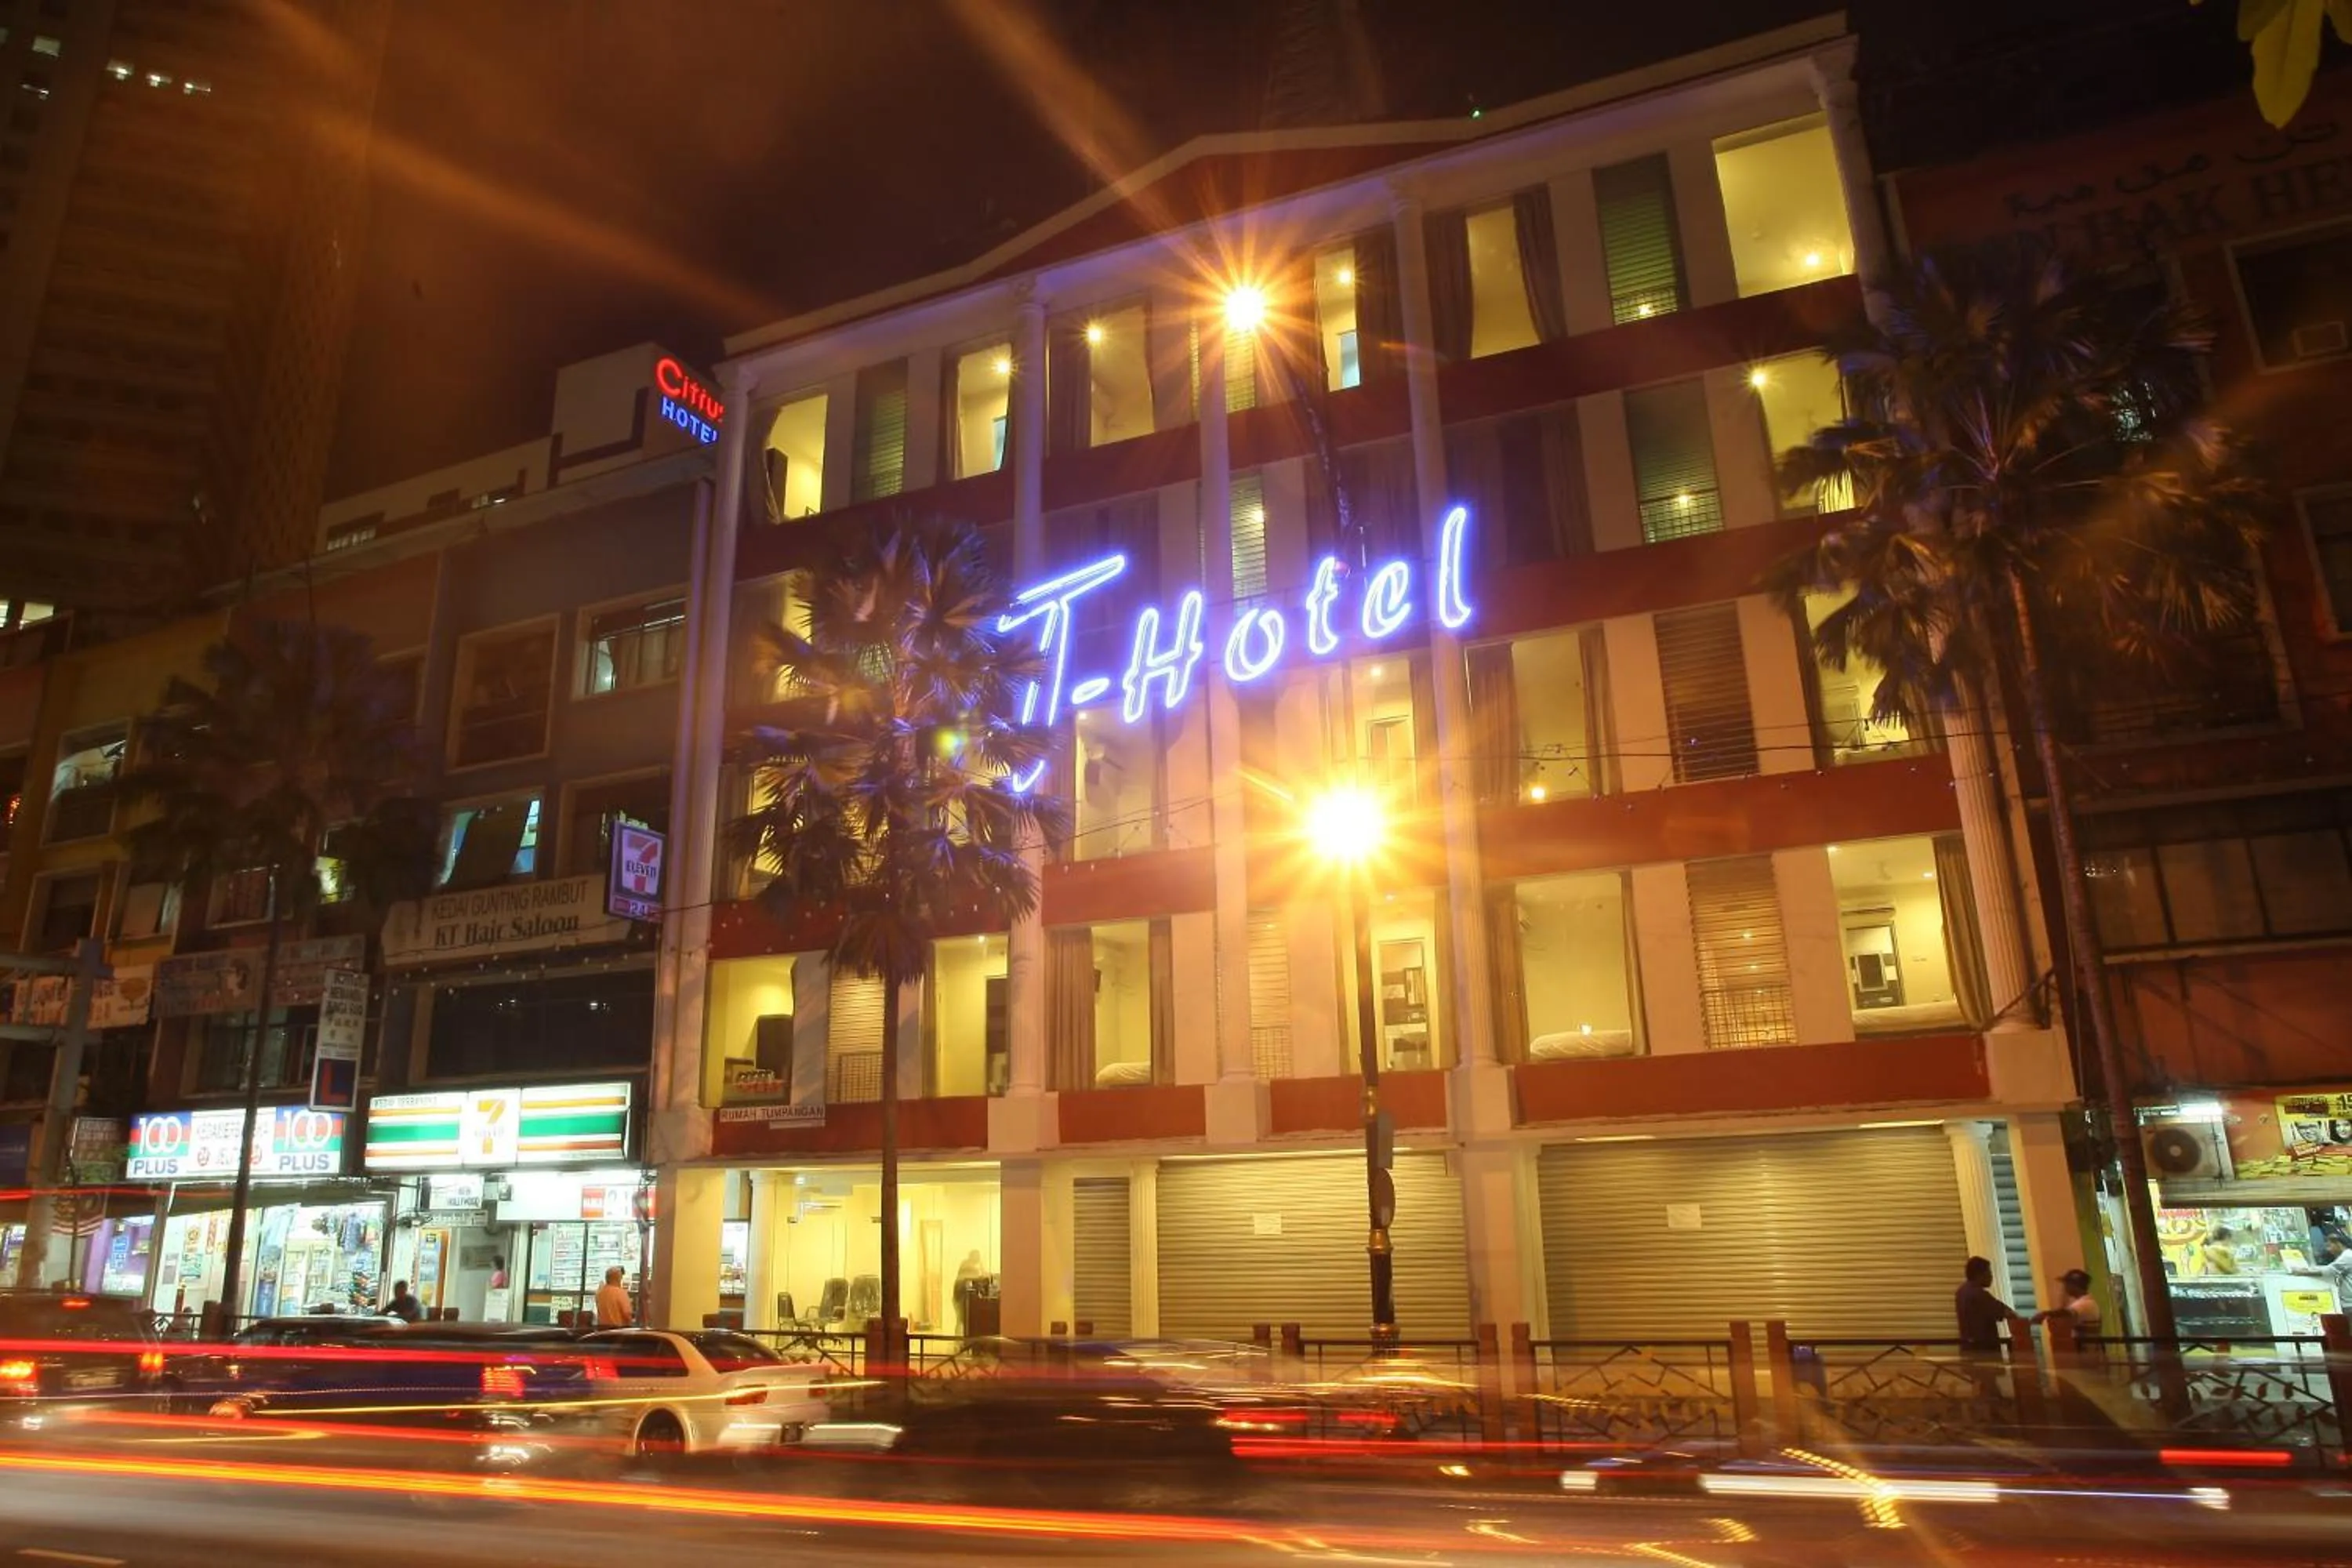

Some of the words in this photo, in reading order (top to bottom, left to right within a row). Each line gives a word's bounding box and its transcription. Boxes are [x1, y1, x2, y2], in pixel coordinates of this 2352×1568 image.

[997, 506, 1472, 792] T-Hotel
[471, 887, 529, 916] GUNTING
[532, 880, 587, 909] RAMBUT
[510, 914, 579, 940] Saloon
[720, 1109, 757, 1121] RUMAH
[762, 1105, 825, 1120] TUMPANGAN
[139, 1116, 183, 1155] 100
[283, 1108, 334, 1152] 100
[132, 1158, 179, 1174] PLUS
[278, 1154, 330, 1171] PLUS
